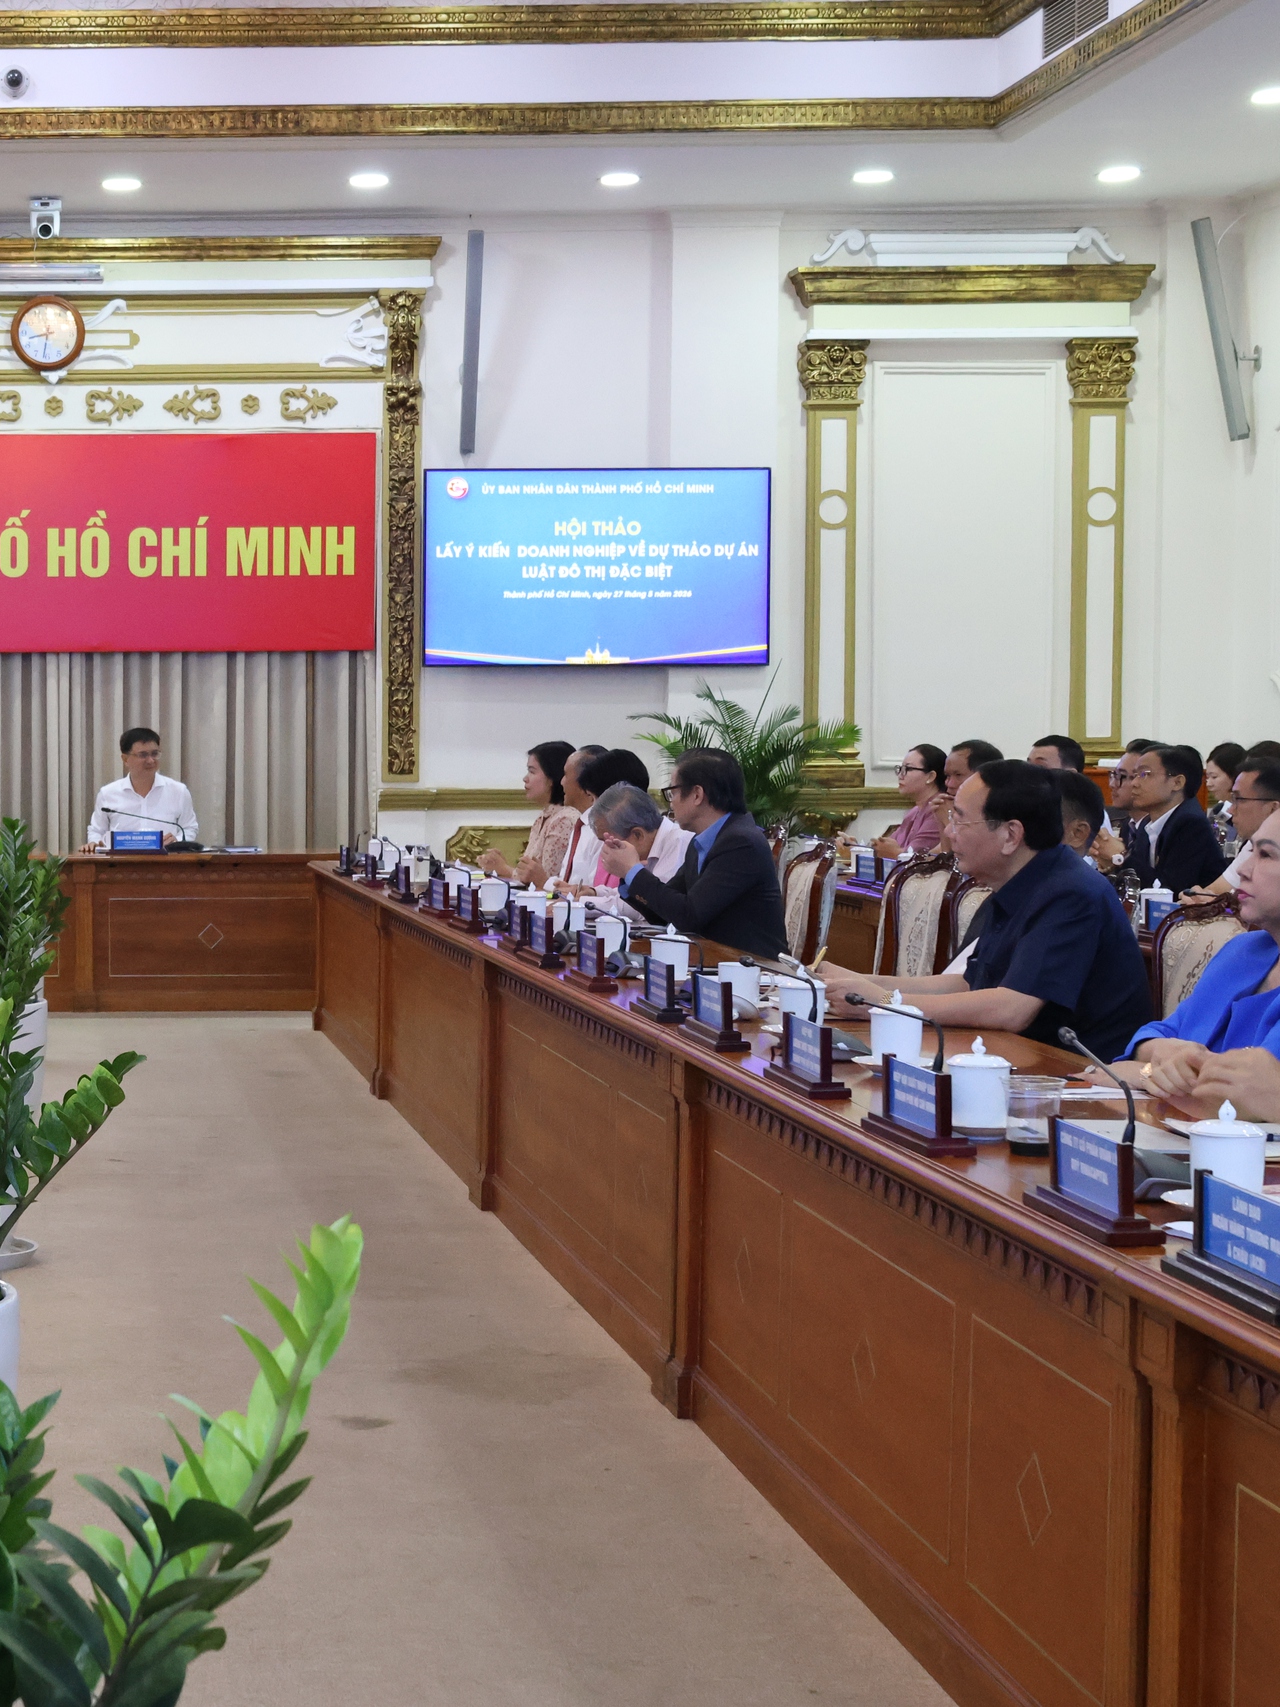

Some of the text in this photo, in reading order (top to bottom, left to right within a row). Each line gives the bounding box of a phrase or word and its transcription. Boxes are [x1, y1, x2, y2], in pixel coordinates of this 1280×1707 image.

[56, 350, 61, 358] 5
[481, 480, 714, 494] ỦY BAN NHÂN DÂN THÀNH PHỐ HỒ CHÍ MINH
[554, 516, 641, 540] HỘI THẢO
[47, 510, 109, 577] HỒ
[129, 517, 208, 577] CHÍ
[227, 527, 355, 576] MINH
[436, 539, 758, 560] LẤY Ý KIẾN DOANH NGHIỆP VỀ DỰ THẢO DỰ ÁN
[522, 562, 673, 581] LUẬT ĐÔ THỊ ĐẶC BIỆT
